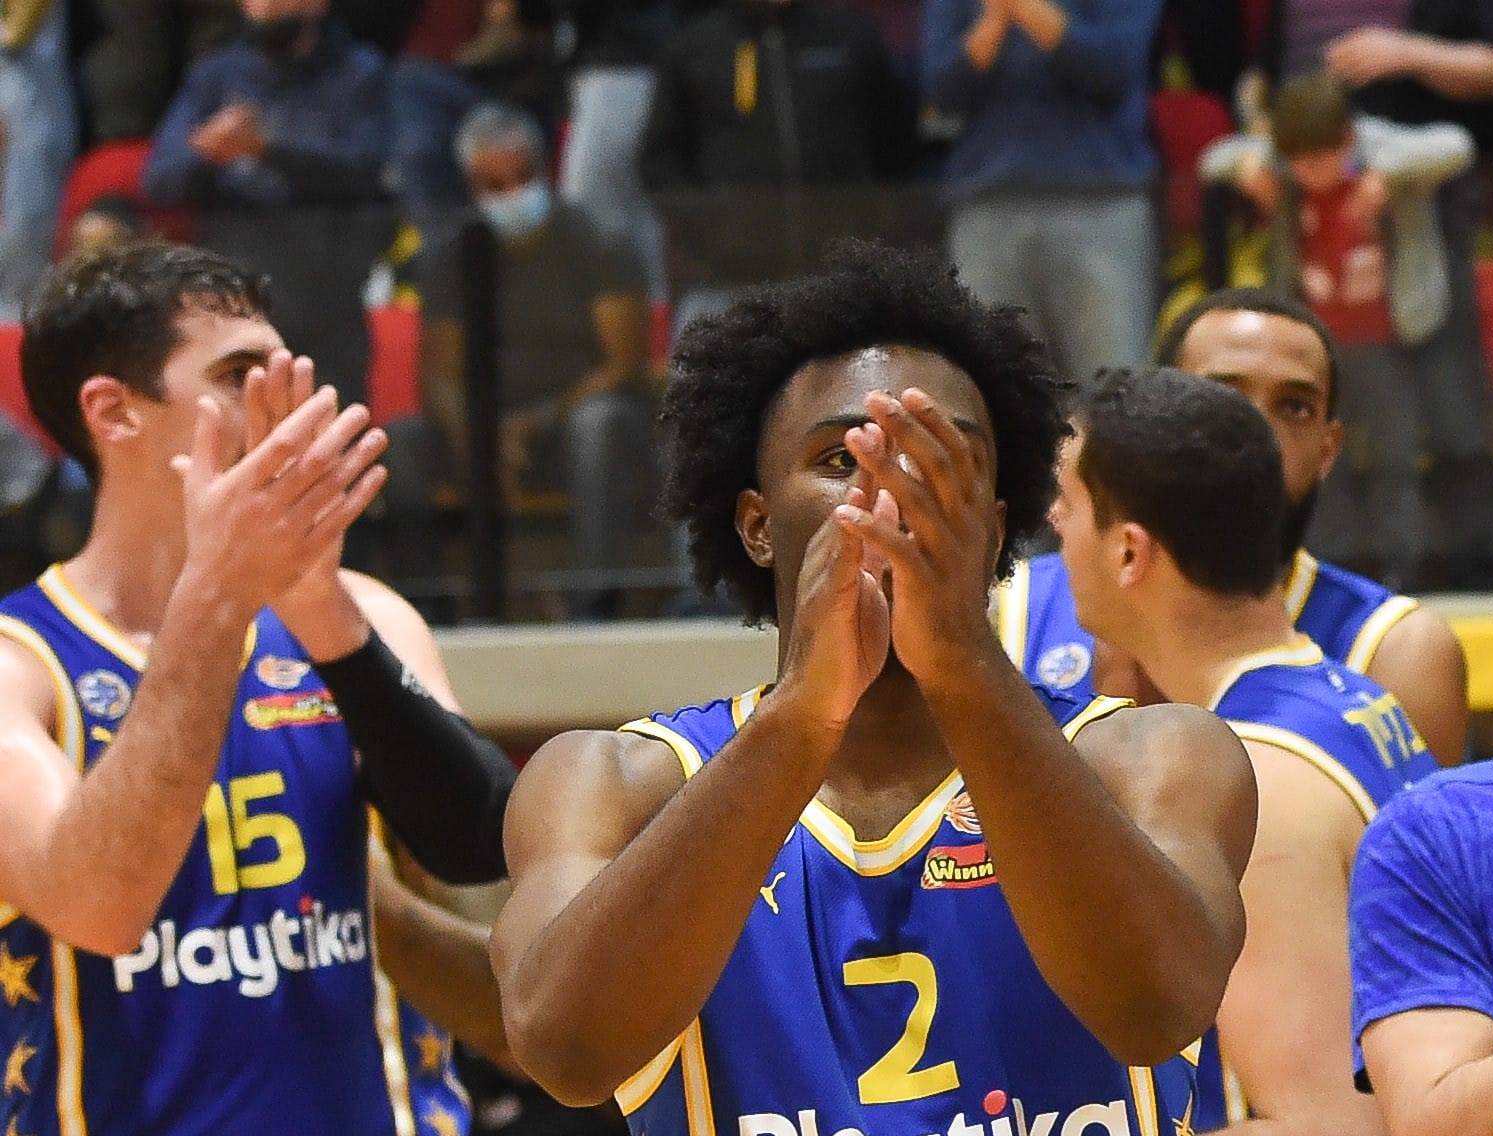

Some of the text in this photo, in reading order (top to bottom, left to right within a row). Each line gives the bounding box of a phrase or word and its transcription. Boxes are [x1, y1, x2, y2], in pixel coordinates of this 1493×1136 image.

[203, 771, 305, 895] 15
[929, 858, 994, 880] Winn
[113, 894, 367, 999] Playtika
[842, 951, 961, 1105] 2
